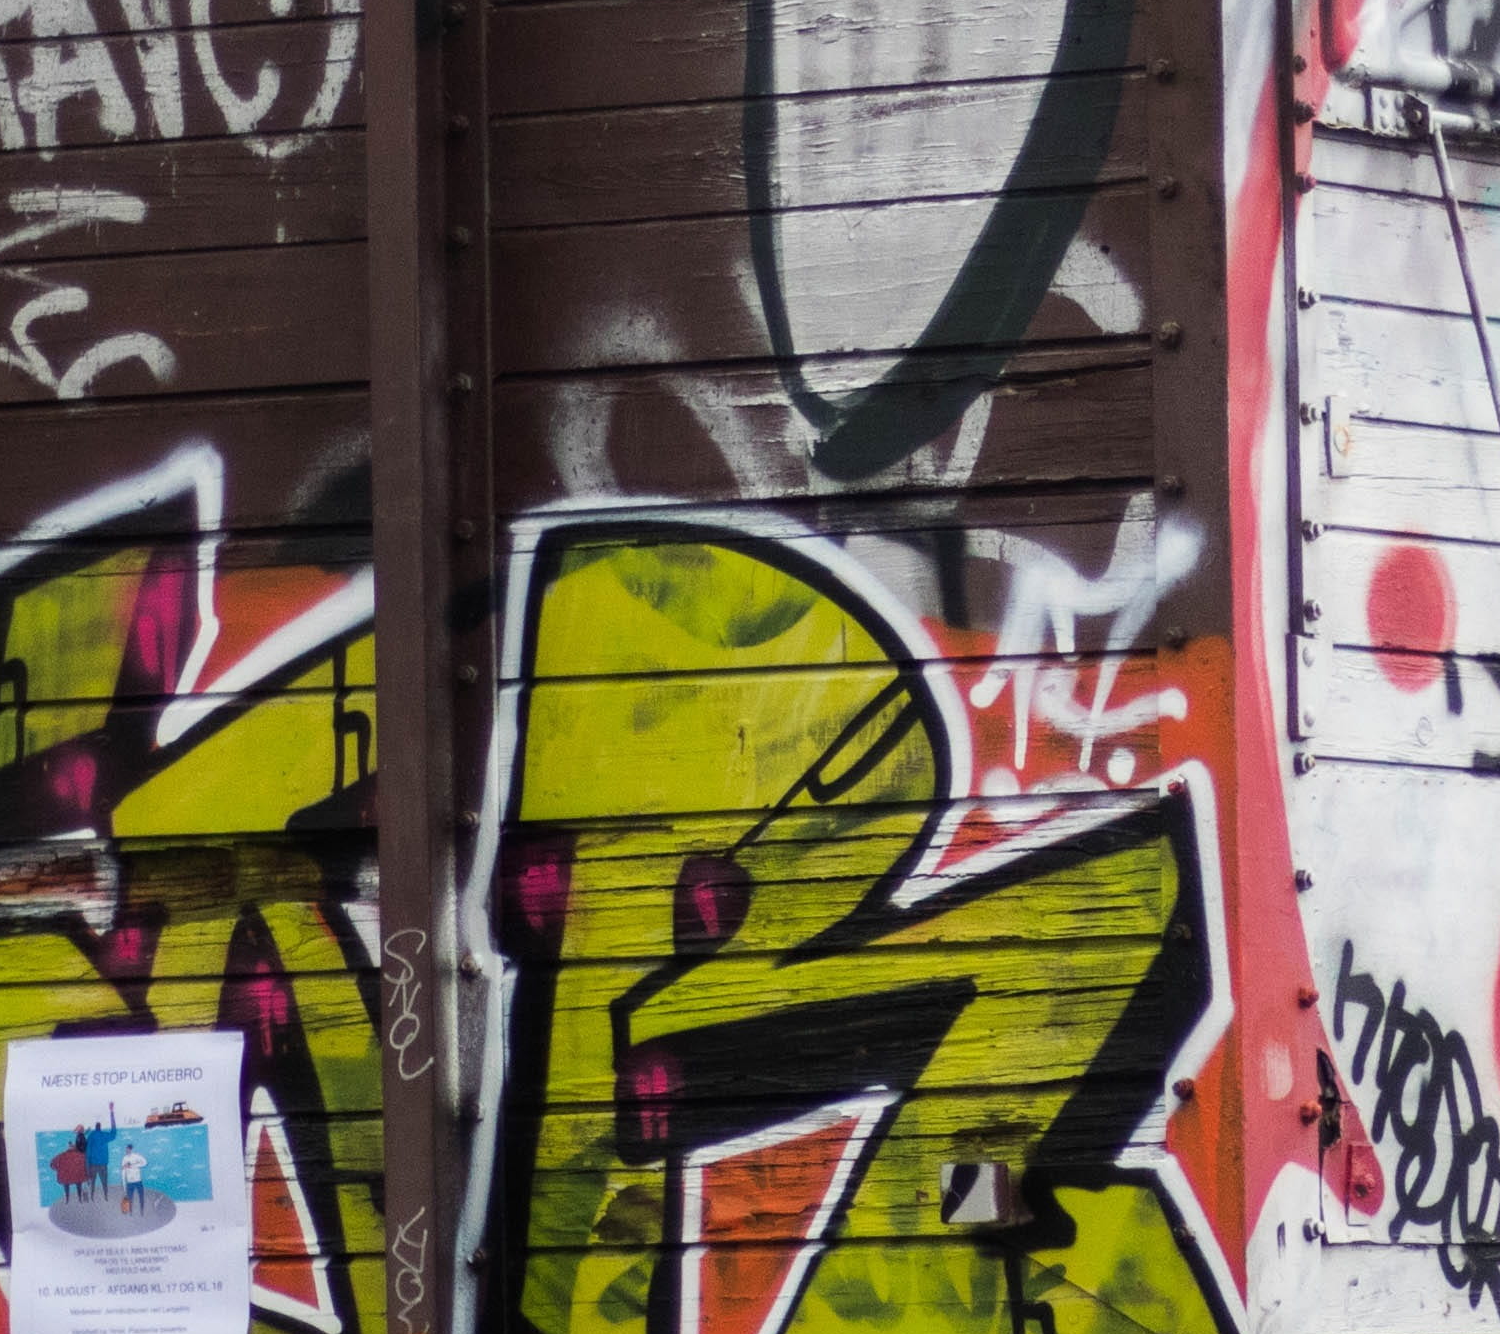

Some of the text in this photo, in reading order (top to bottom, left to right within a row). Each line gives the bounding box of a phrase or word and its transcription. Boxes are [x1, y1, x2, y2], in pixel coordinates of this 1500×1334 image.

[41, 1067, 203, 1088] NÆSTE STOP LANGEBRO
[54, 1285, 97, 1297] AUGUST
